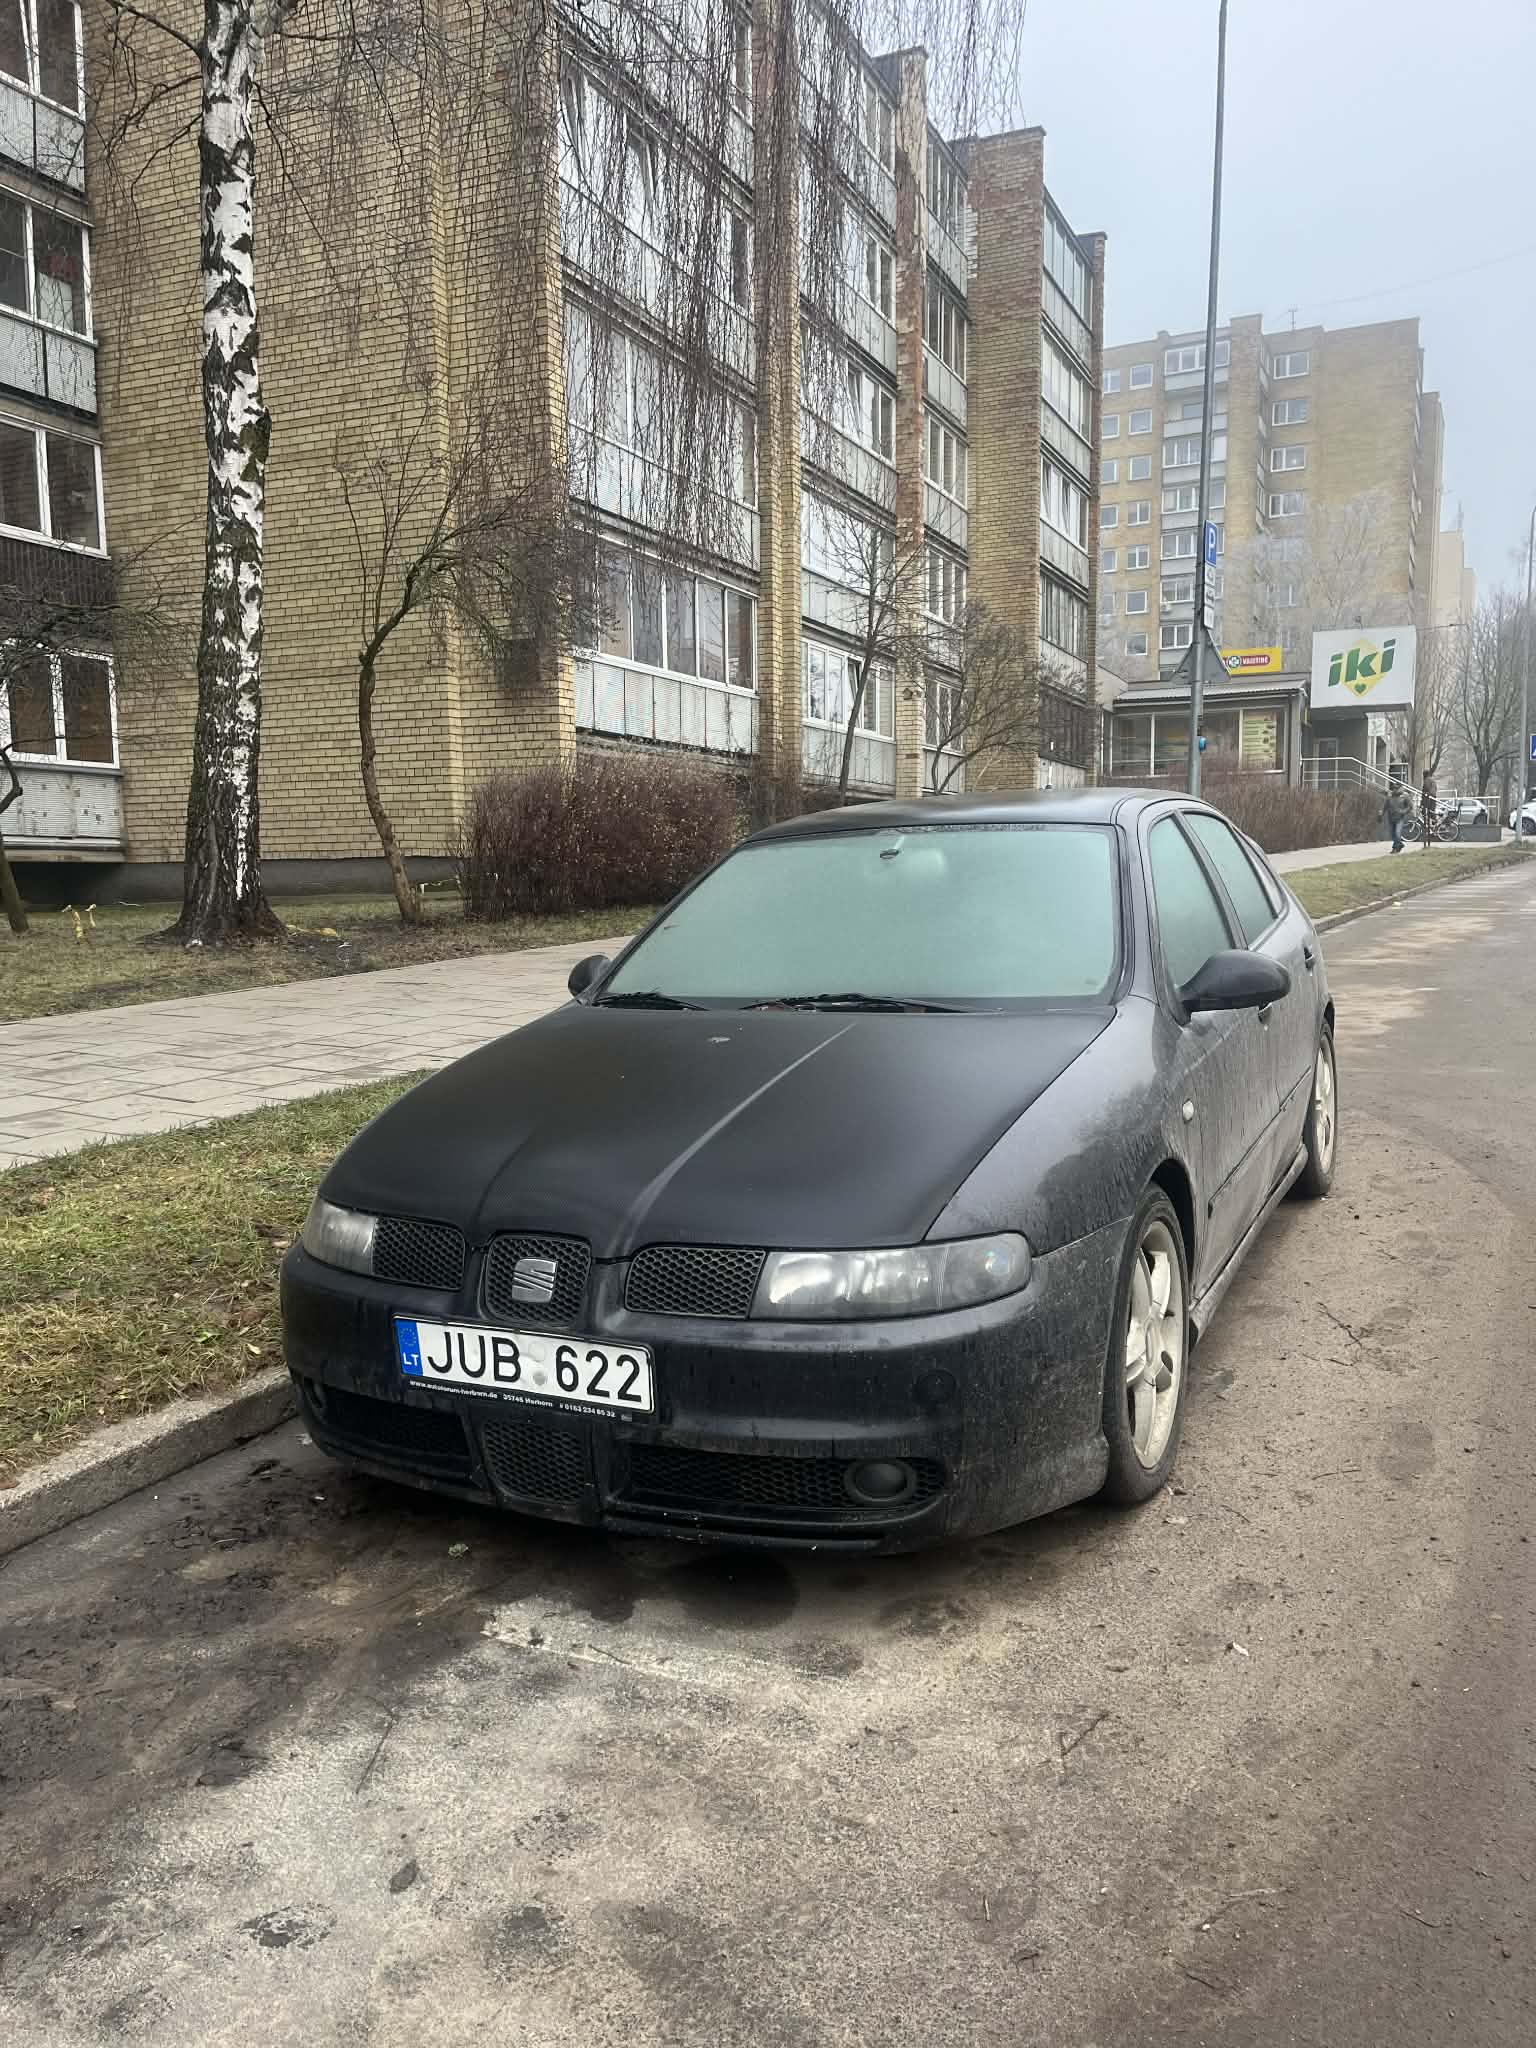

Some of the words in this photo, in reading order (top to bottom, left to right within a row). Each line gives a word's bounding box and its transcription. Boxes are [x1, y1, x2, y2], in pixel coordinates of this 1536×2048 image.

[1208, 527, 1216, 561] P
[1328, 639, 1397, 687] iki
[402, 1352, 420, 1367] LT
[427, 1331, 522, 1383] JUB
[555, 1345, 642, 1403] 622
